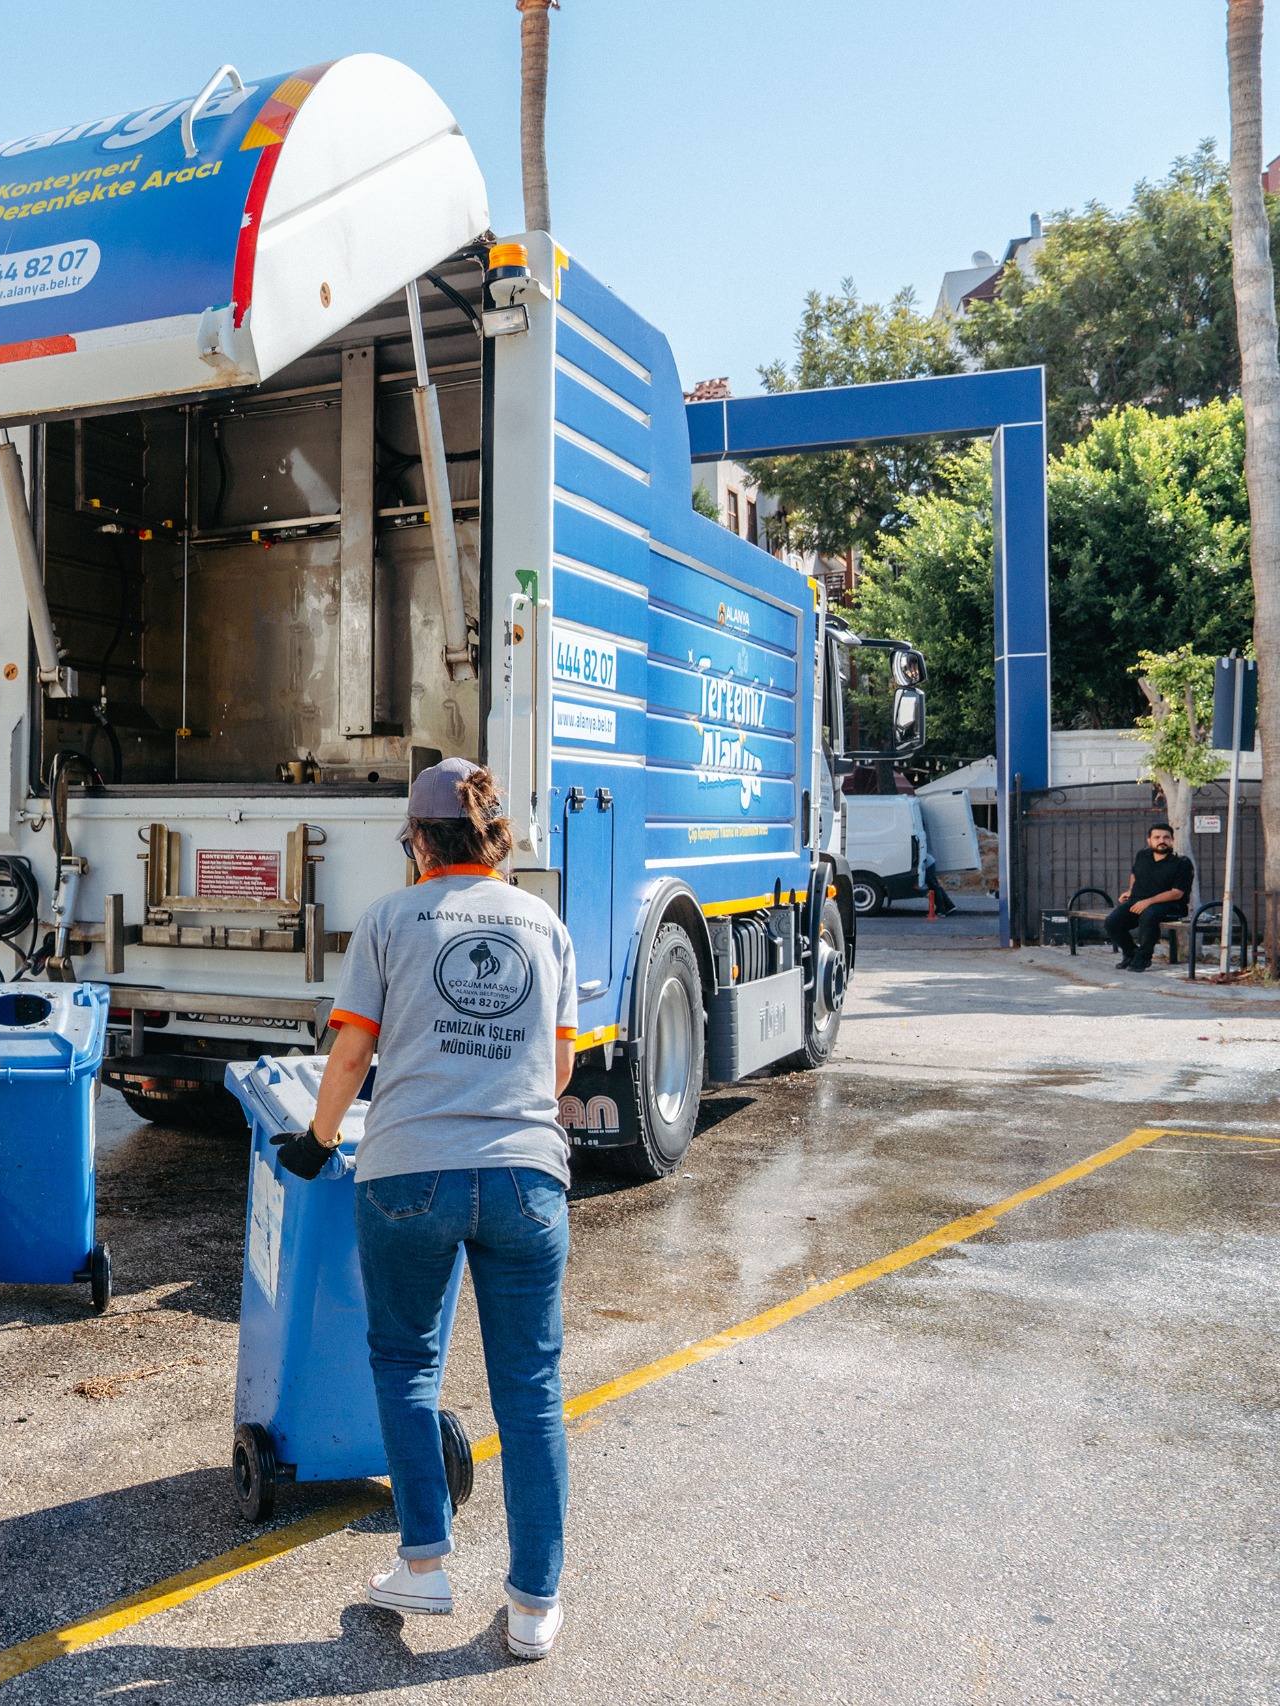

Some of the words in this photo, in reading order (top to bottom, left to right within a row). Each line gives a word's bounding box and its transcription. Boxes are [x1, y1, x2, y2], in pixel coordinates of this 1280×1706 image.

[141, 160, 223, 191] Aracı
[24, 254, 54, 279] 82
[58, 247, 89, 272] 07
[726, 606, 749, 627] ALANYA
[557, 642, 581, 679] 444
[584, 648, 598, 682] 82
[600, 652, 614, 685] 07
[557, 711, 613, 734] www.alanya.bel.tr
[417, 911, 474, 923] ALANYA
[477, 913, 552, 938] BELEDİYESİ
[448, 979, 482, 990] ÇÖZÜM
[483, 981, 518, 994] MASASI
[455, 988, 479, 997] ALANYA
[456, 996, 476, 1006] 444
[479, 998, 492, 1008] 82
[493, 1000, 507, 1010] 07
[489, 1025, 526, 1042] İŞLERİ
[439, 1038, 512, 1060] MÜDÜRLÜĞÜ
